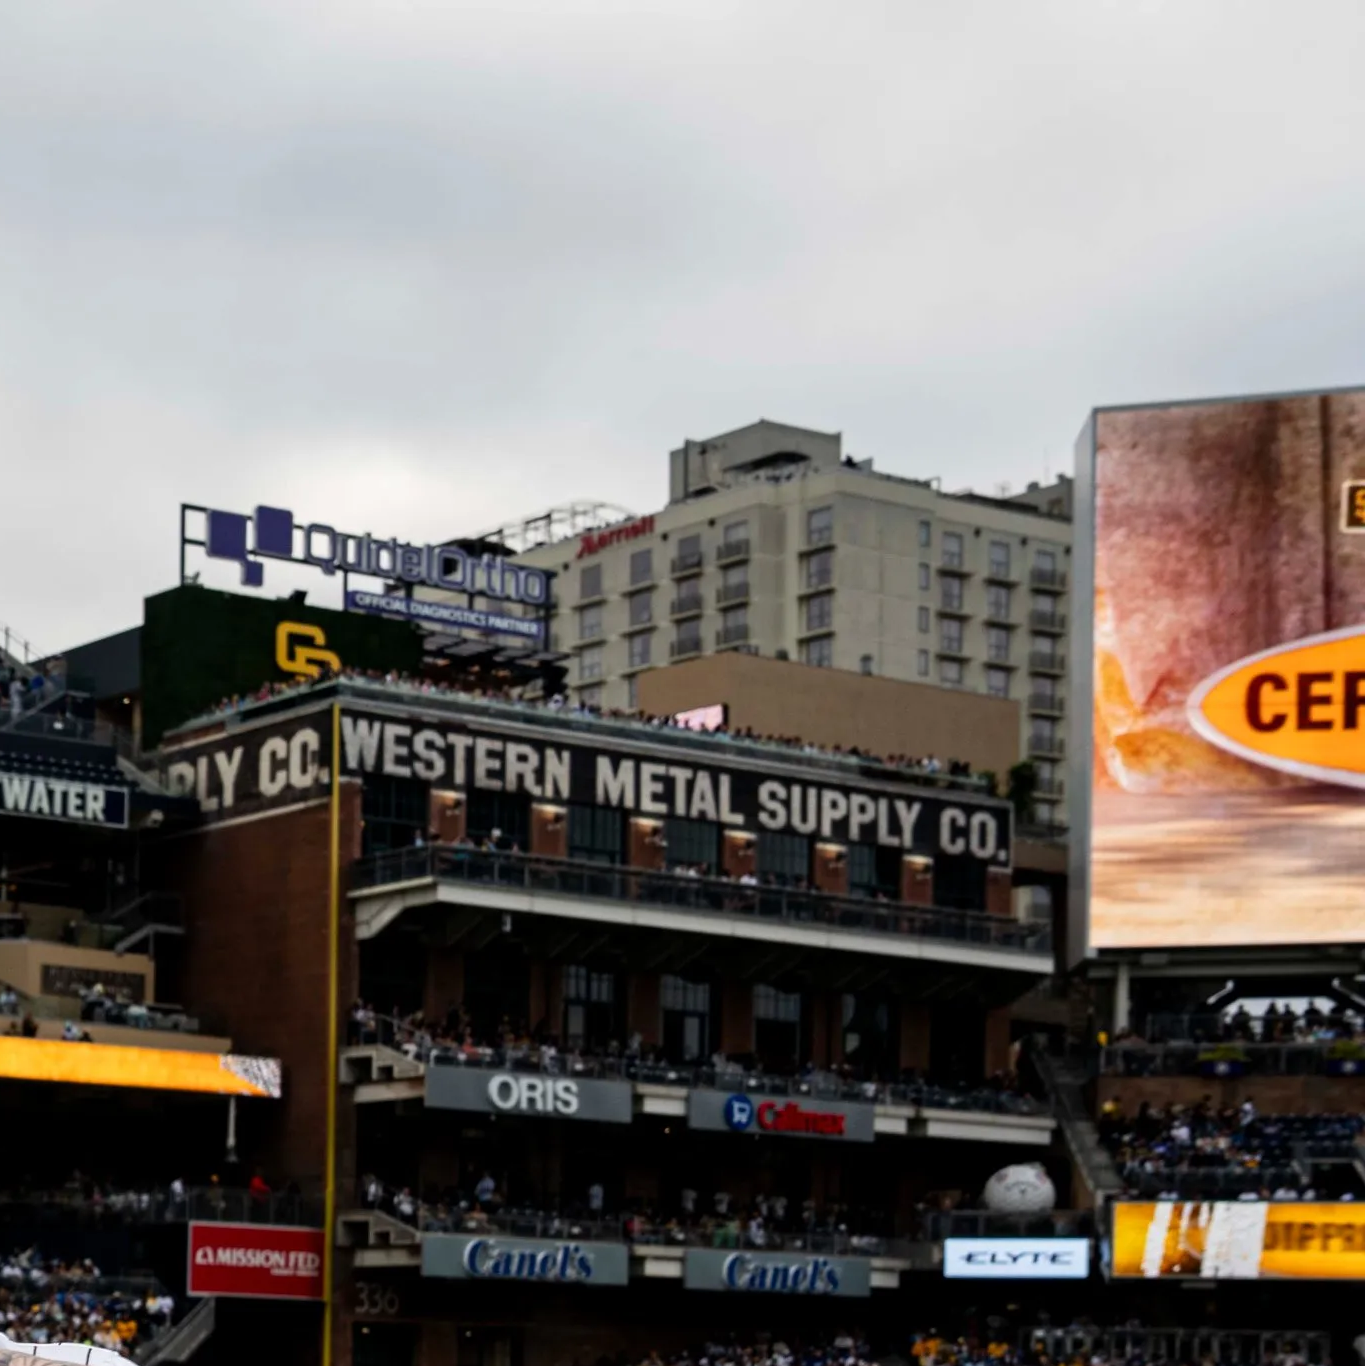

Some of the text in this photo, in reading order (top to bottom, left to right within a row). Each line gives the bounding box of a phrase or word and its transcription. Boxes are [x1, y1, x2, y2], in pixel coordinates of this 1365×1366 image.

[304, 522, 547, 603] QuidelOrtho
[355, 592, 538, 636] OFFICIAL DIAGNOSTICS PARTNER
[258, 727, 330, 798] CO.
[339, 715, 1009, 861] WESTERN METAL SUPPLY CO.
[487, 1073, 580, 1115] ORIS
[215, 1246, 321, 1270] MISSION FED
[463, 1237, 594, 1281] Canel's
[723, 1251, 840, 1293] Canel's
[958, 1250, 1075, 1266] ELYTE
[354, 1279, 400, 1316] 336
